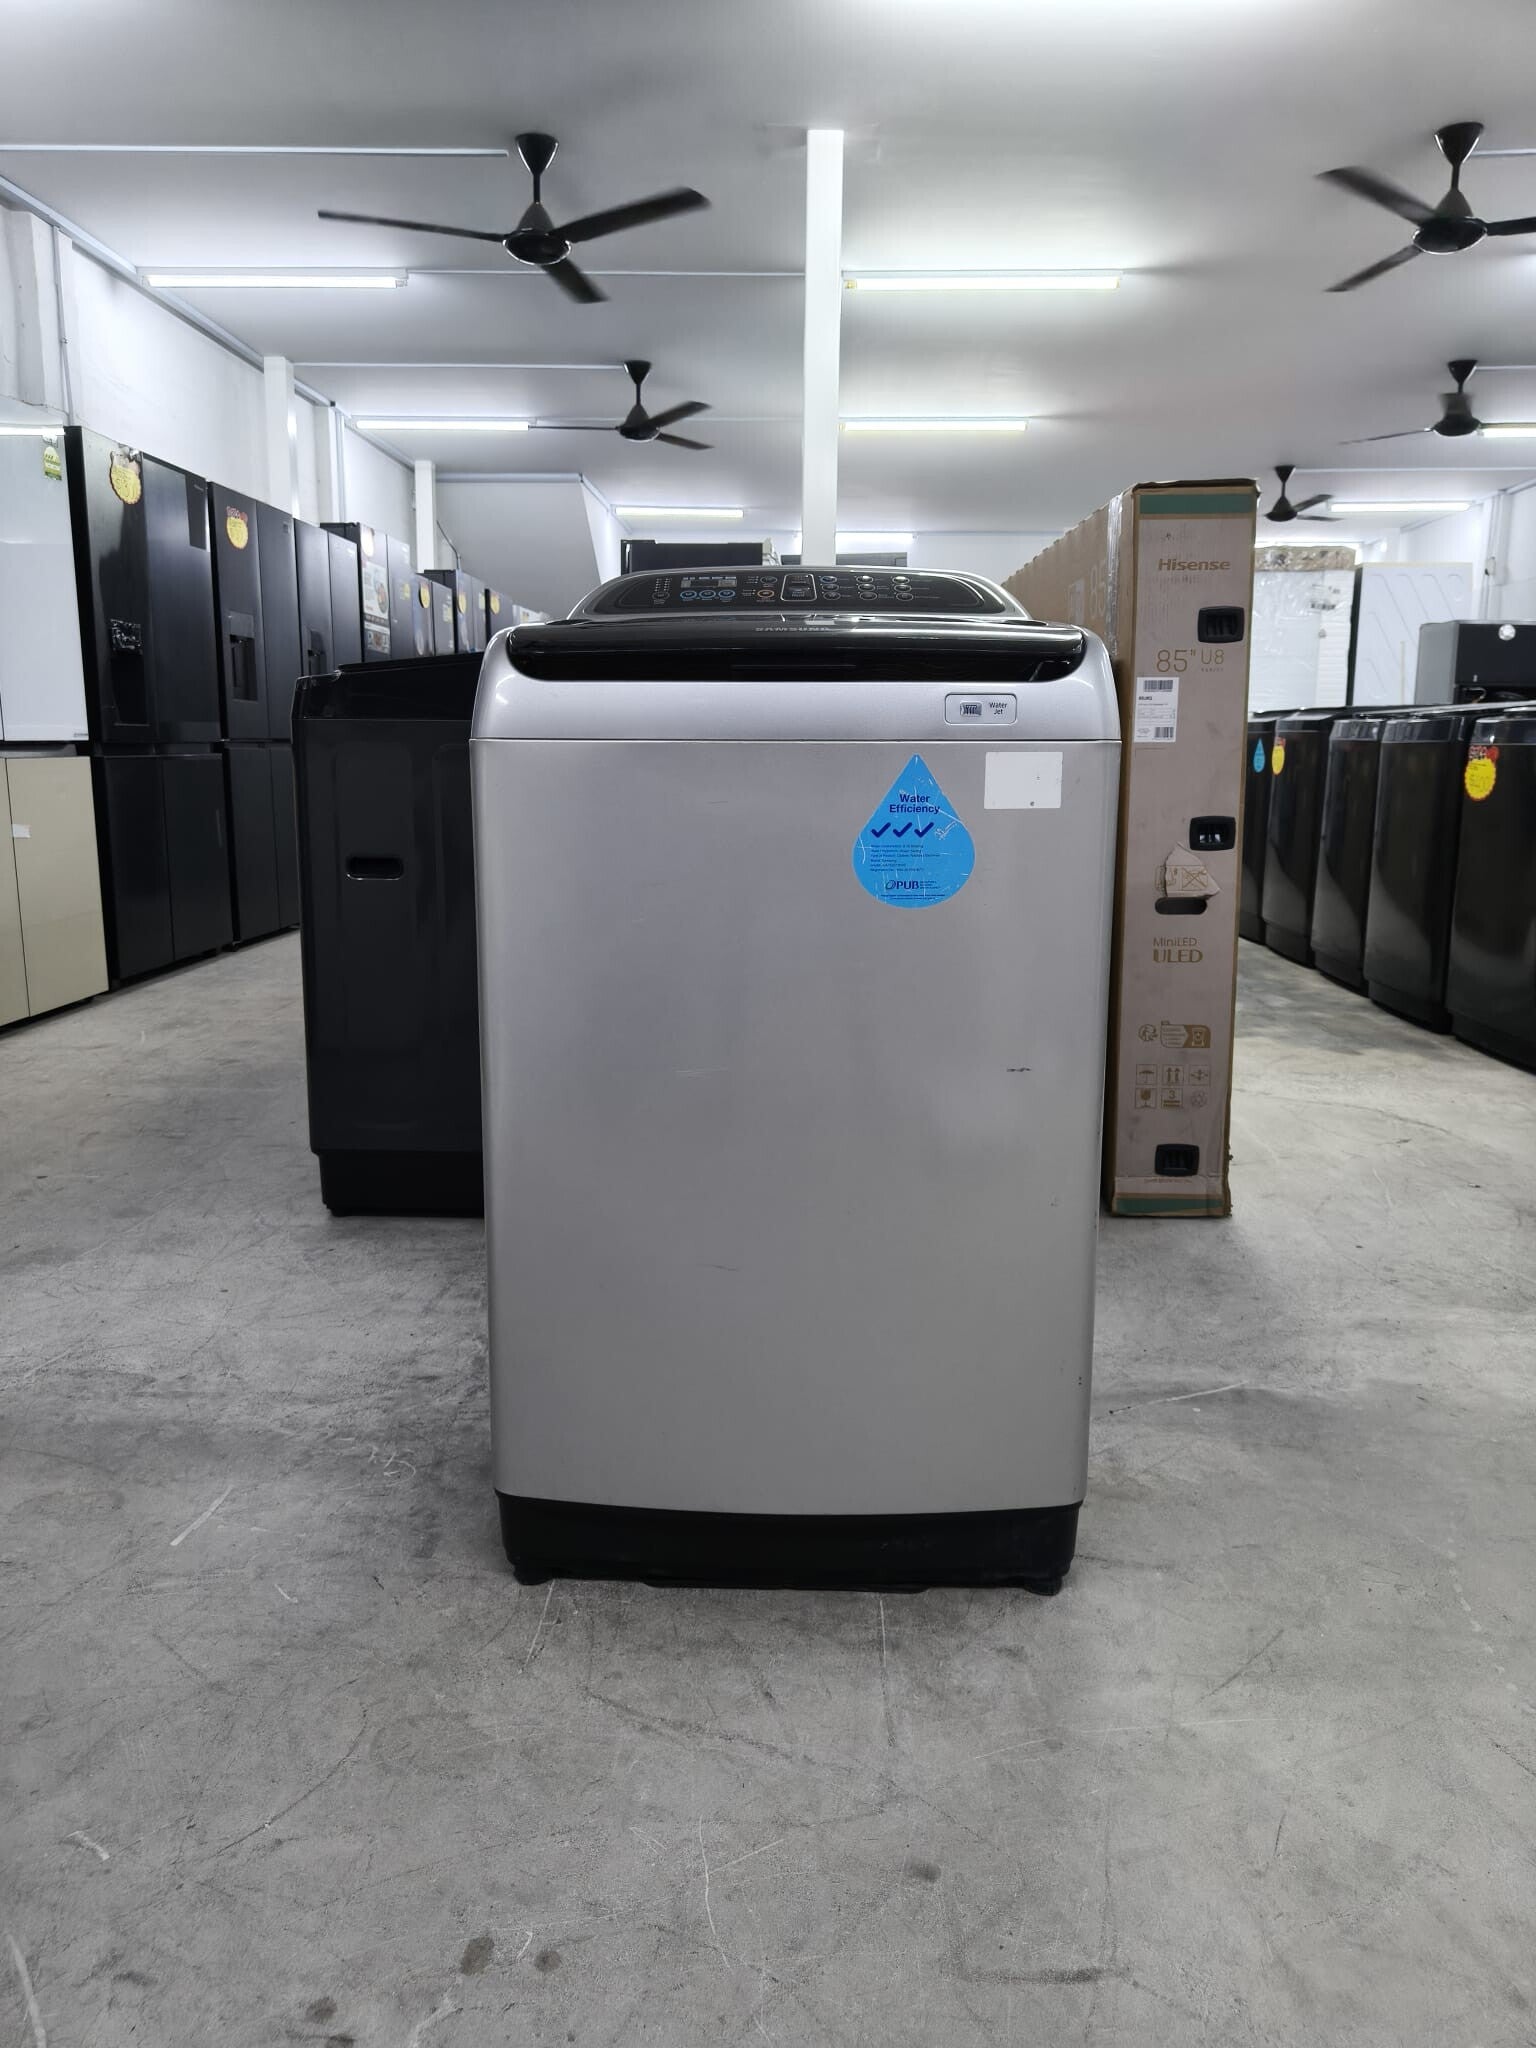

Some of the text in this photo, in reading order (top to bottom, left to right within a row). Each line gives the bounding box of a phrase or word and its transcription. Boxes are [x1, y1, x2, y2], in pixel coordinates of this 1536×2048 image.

[1157, 558, 1230, 571] Hisense
[1201, 648, 1224, 665] U8
[899, 794, 930, 803] Water
[889, 804, 940, 815] Efficiency
[896, 880, 919, 890] PUB
[1153, 949, 1203, 963] ULED
